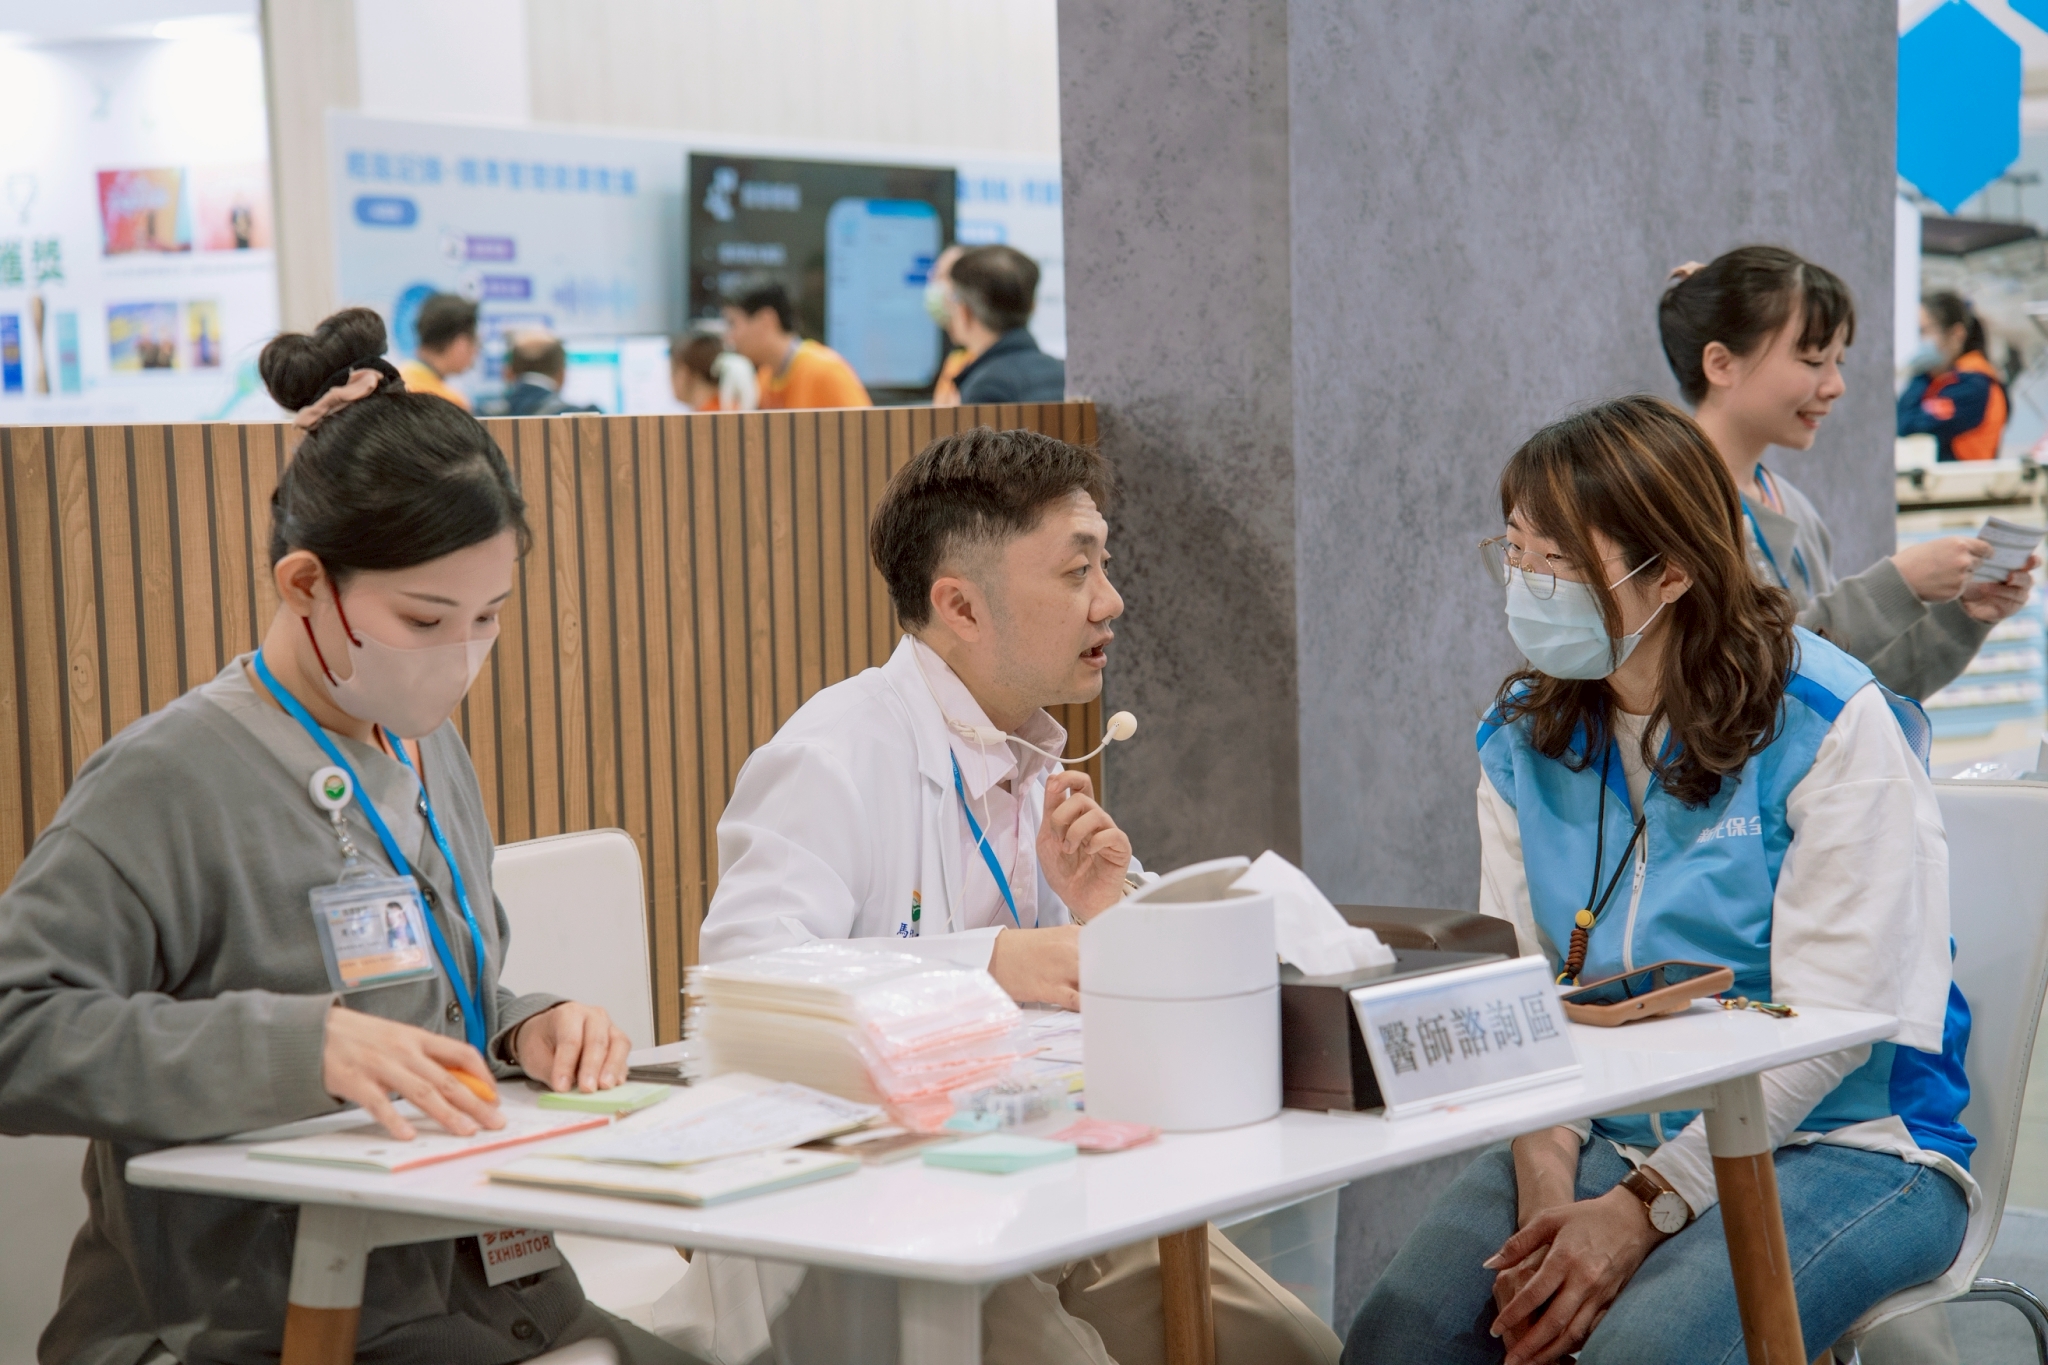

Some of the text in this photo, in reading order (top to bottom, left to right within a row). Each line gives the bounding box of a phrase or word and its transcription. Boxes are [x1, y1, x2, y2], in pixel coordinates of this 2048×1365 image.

[1378, 991, 1559, 1075] 醫師諮詢區
[487, 1235, 551, 1265] EXHIBITOR
